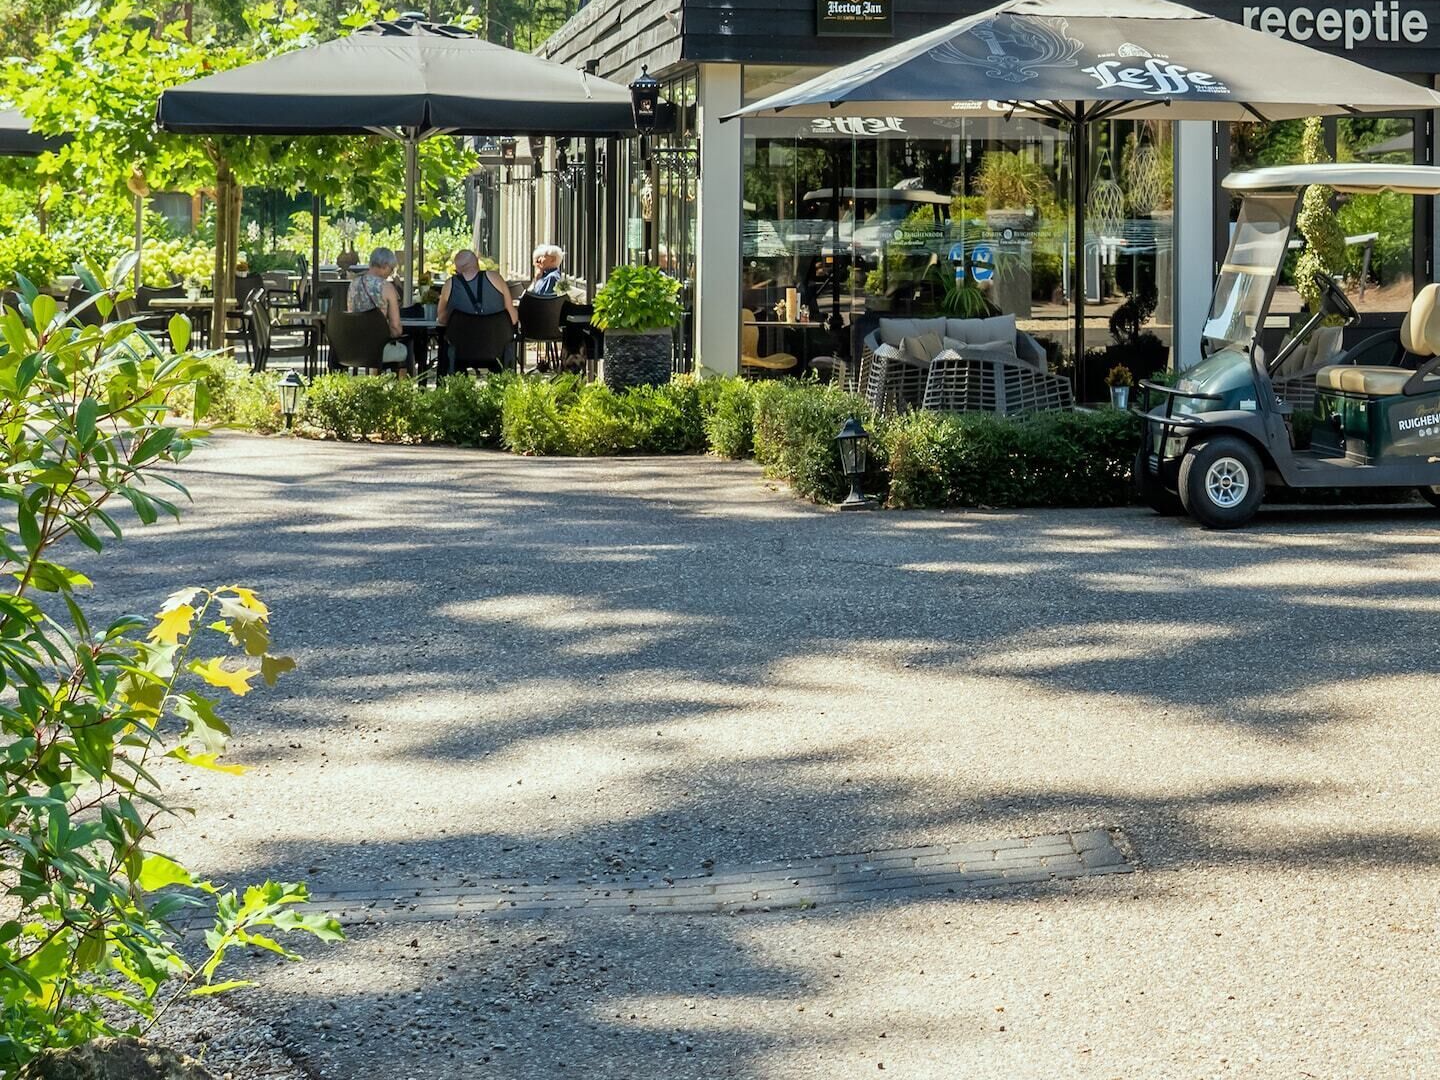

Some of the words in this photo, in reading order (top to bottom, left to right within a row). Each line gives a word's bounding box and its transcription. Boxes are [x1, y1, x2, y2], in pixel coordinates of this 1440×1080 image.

[827, 0, 861, 16] Hertog
[862, 1, 882, 17] Jan
[1242, 0, 1428, 50] receptie
[1081, 58, 1217, 95] Leffe
